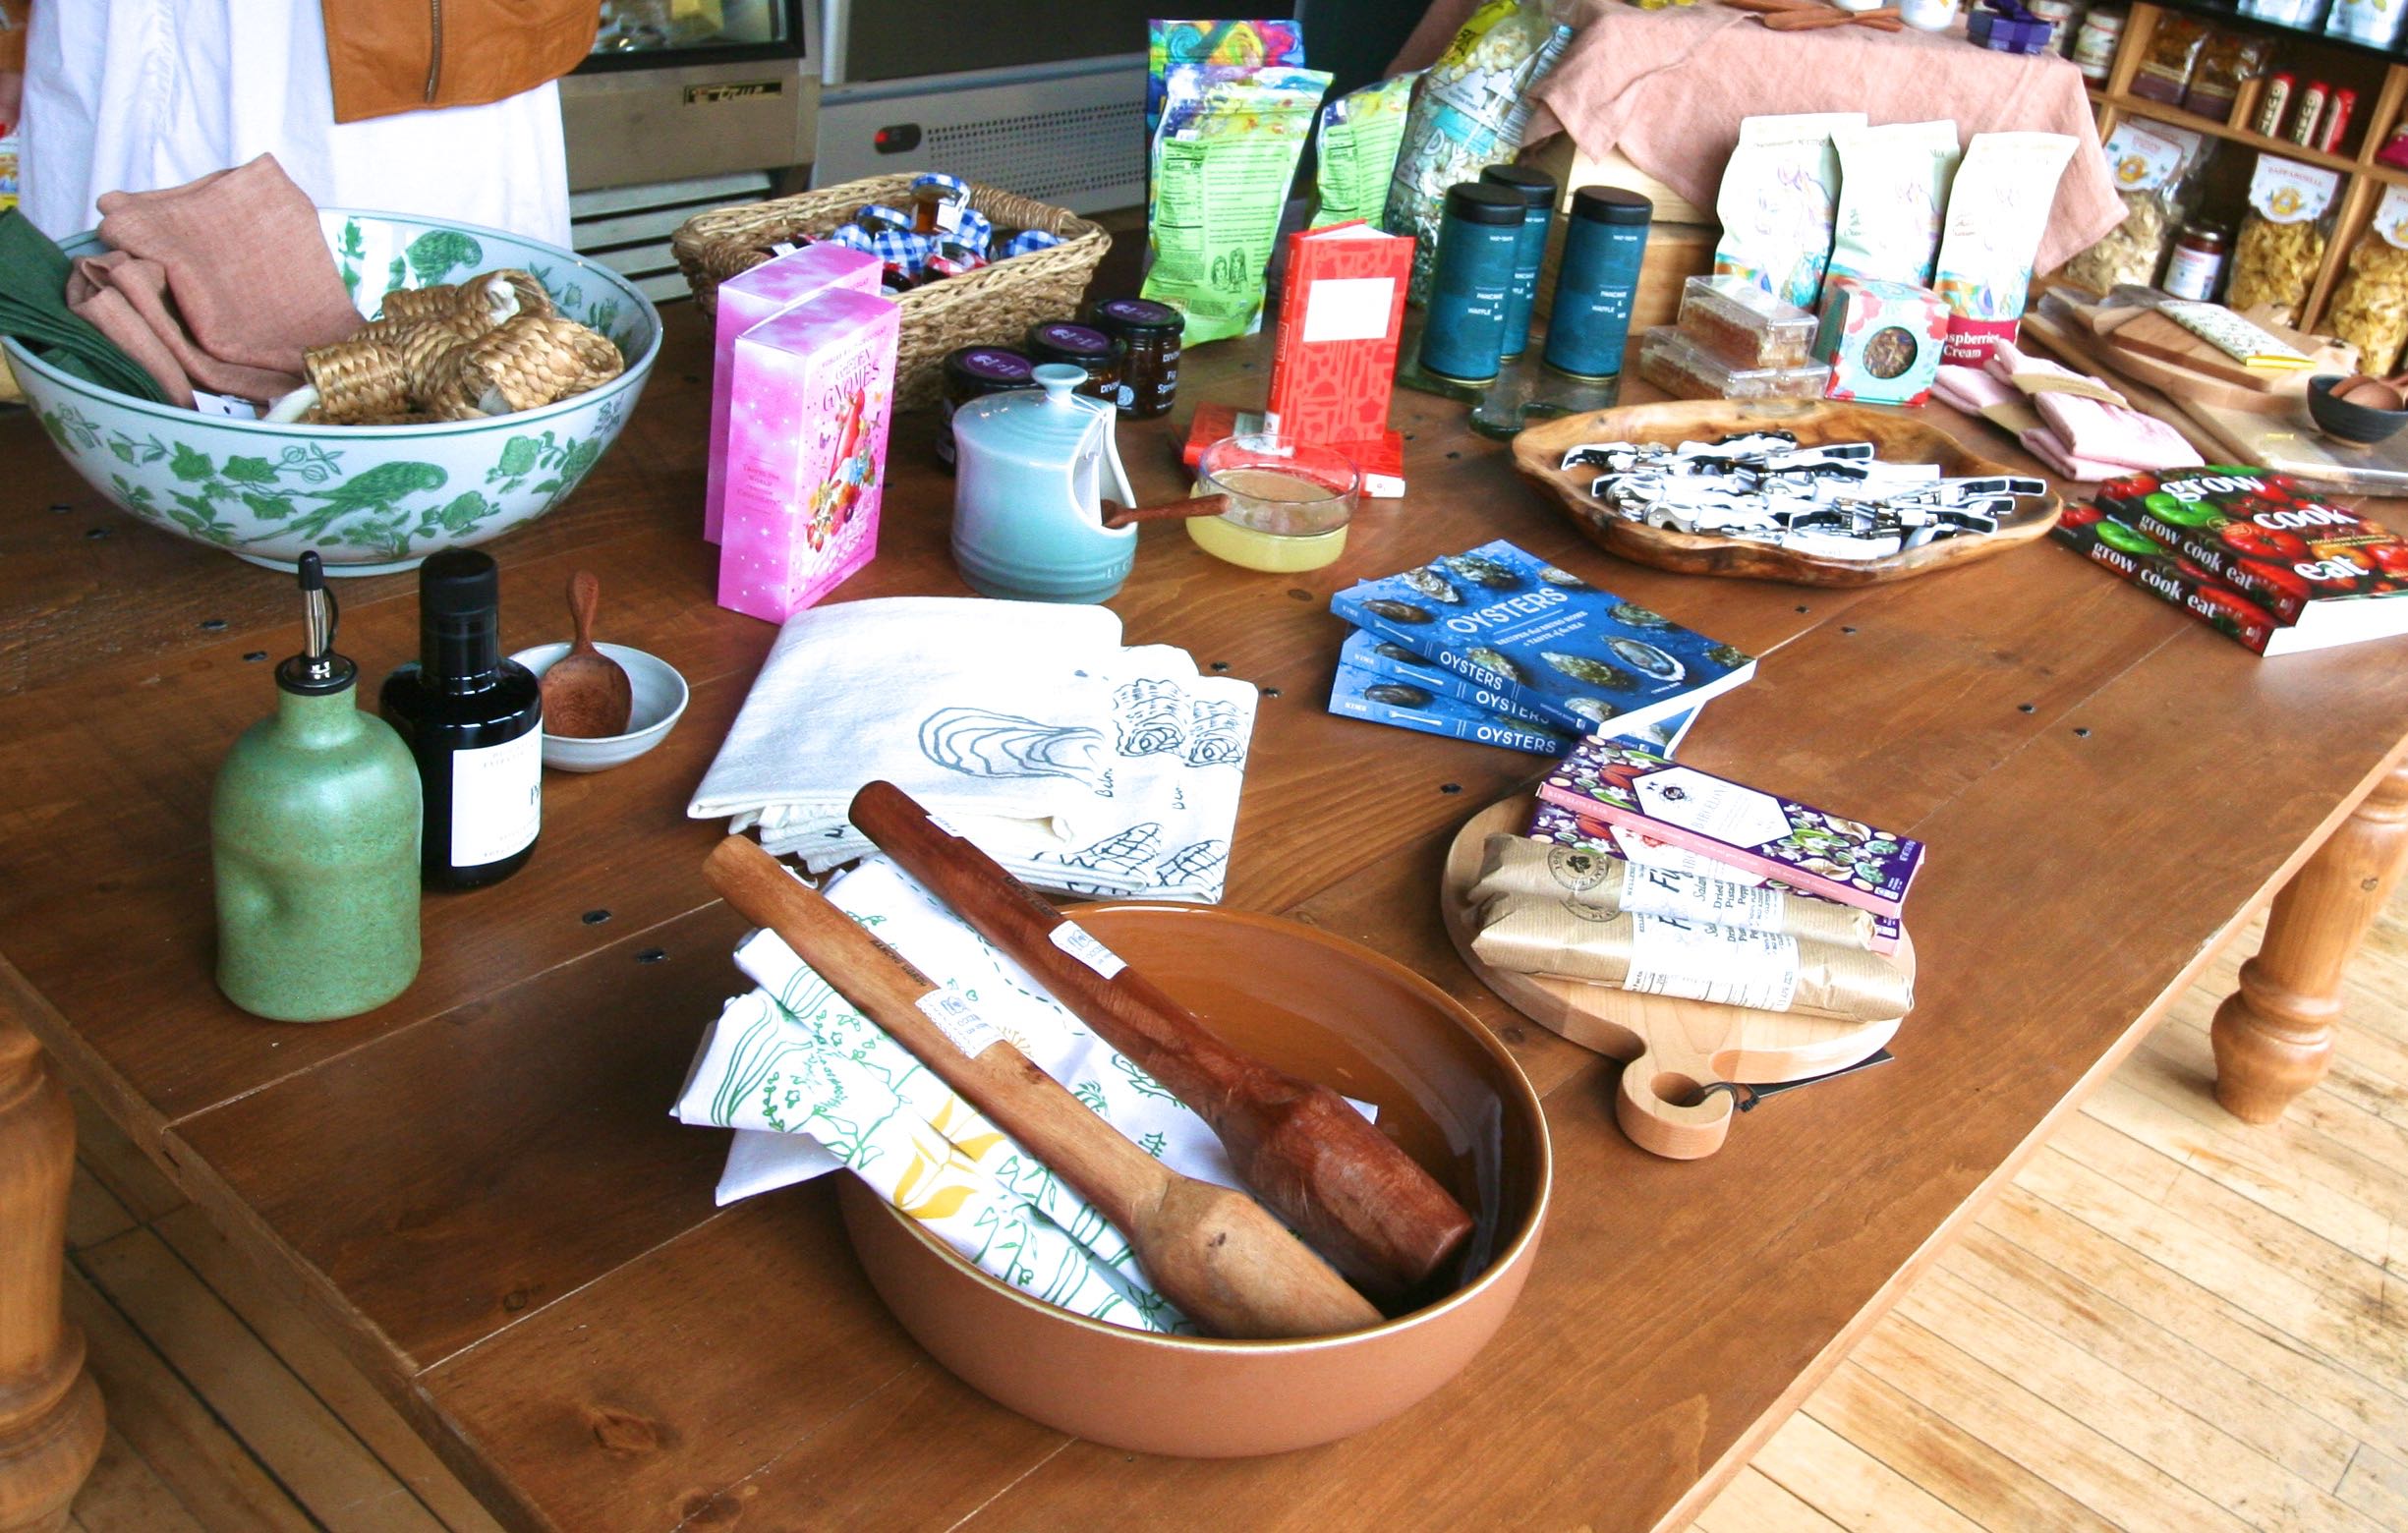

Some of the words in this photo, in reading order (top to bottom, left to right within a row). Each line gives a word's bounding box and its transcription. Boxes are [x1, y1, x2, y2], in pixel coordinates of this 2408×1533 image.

[1943, 345, 1981, 359] Cream
[1946, 330, 2000, 347] spberries
[2159, 473, 2266, 504] grow
[2252, 502, 2359, 530] cook
[2139, 514, 2181, 544] grow
[2183, 540, 2223, 573] cook
[2225, 565, 2256, 591] eat
[2293, 554, 2370, 581] eat
[2092, 541, 2138, 574] grow
[2140, 566, 2183, 601] cook
[2187, 594, 2219, 619] eat
[1446, 587, 1569, 634] OYSTERS
[1440, 650, 1504, 691] OYSTERS
[1476, 725, 1557, 754] OYSTERS
